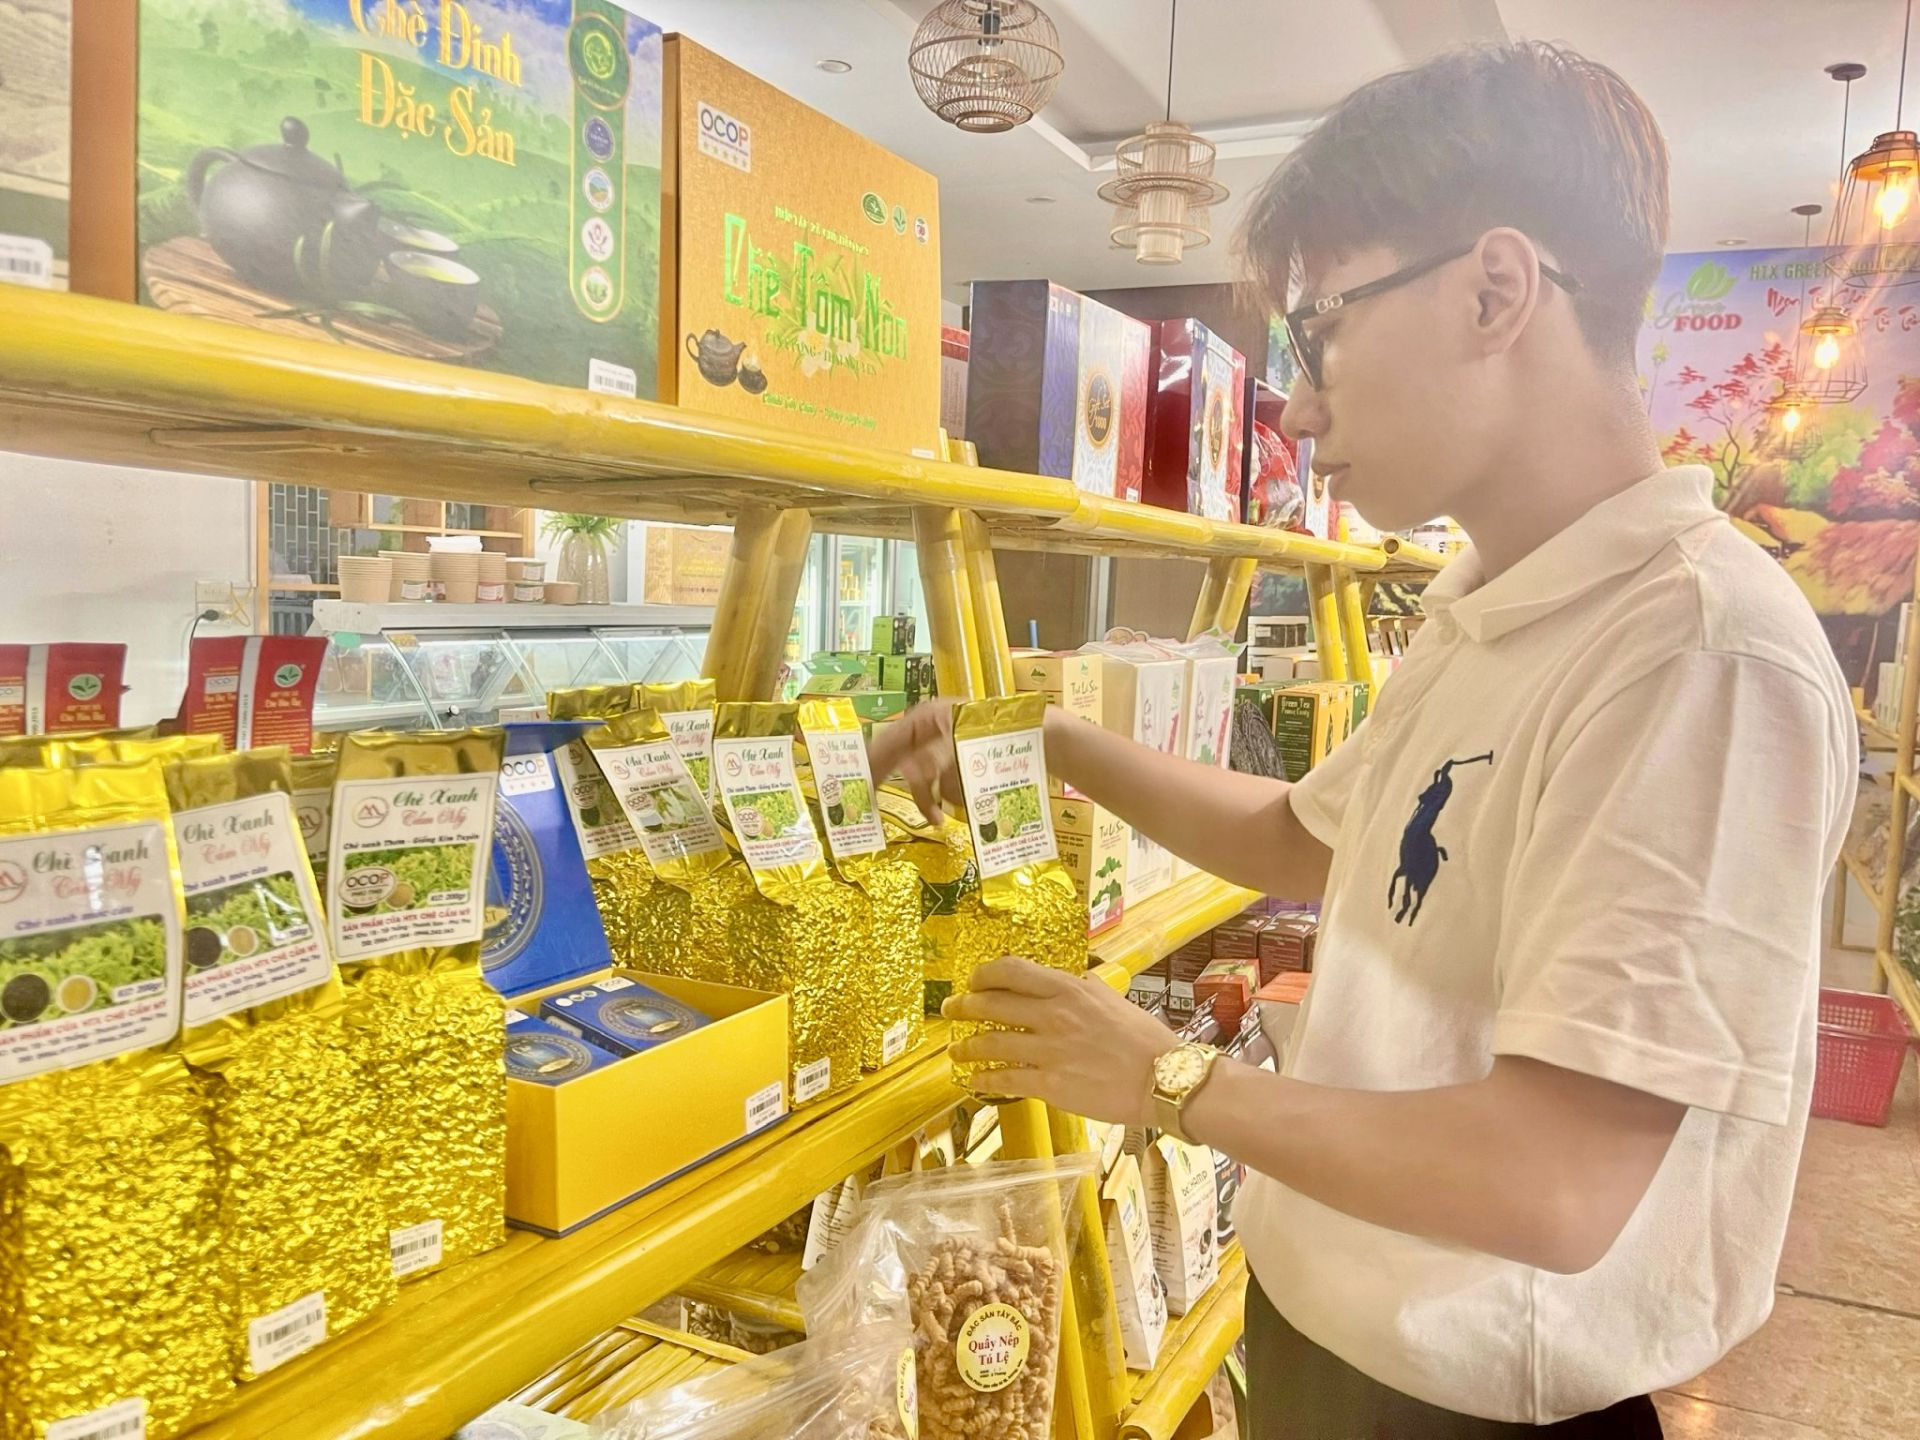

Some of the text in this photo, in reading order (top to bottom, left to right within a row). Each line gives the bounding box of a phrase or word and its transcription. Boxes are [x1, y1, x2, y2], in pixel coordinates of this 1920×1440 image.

[356, 50, 516, 166] Đặc Sản
[701, 108, 748, 147] OCOP
[1673, 313, 1743, 332] FOOD
[1006, 740, 1033, 757] Xanh
[501, 759, 546, 777] OCOP
[393, 787, 479, 807] Chè Xanh
[183, 808, 275, 845] Chè Xanh
[33, 850, 72, 874] Chè
[346, 872, 389, 888] OCOP
[980, 1311, 995, 1322] SẢN
[997, 1309, 1011, 1320] TÂY
[968, 1331, 1019, 1354] Quẩy Nếp
[979, 1351, 1009, 1366] Tú Lệ
